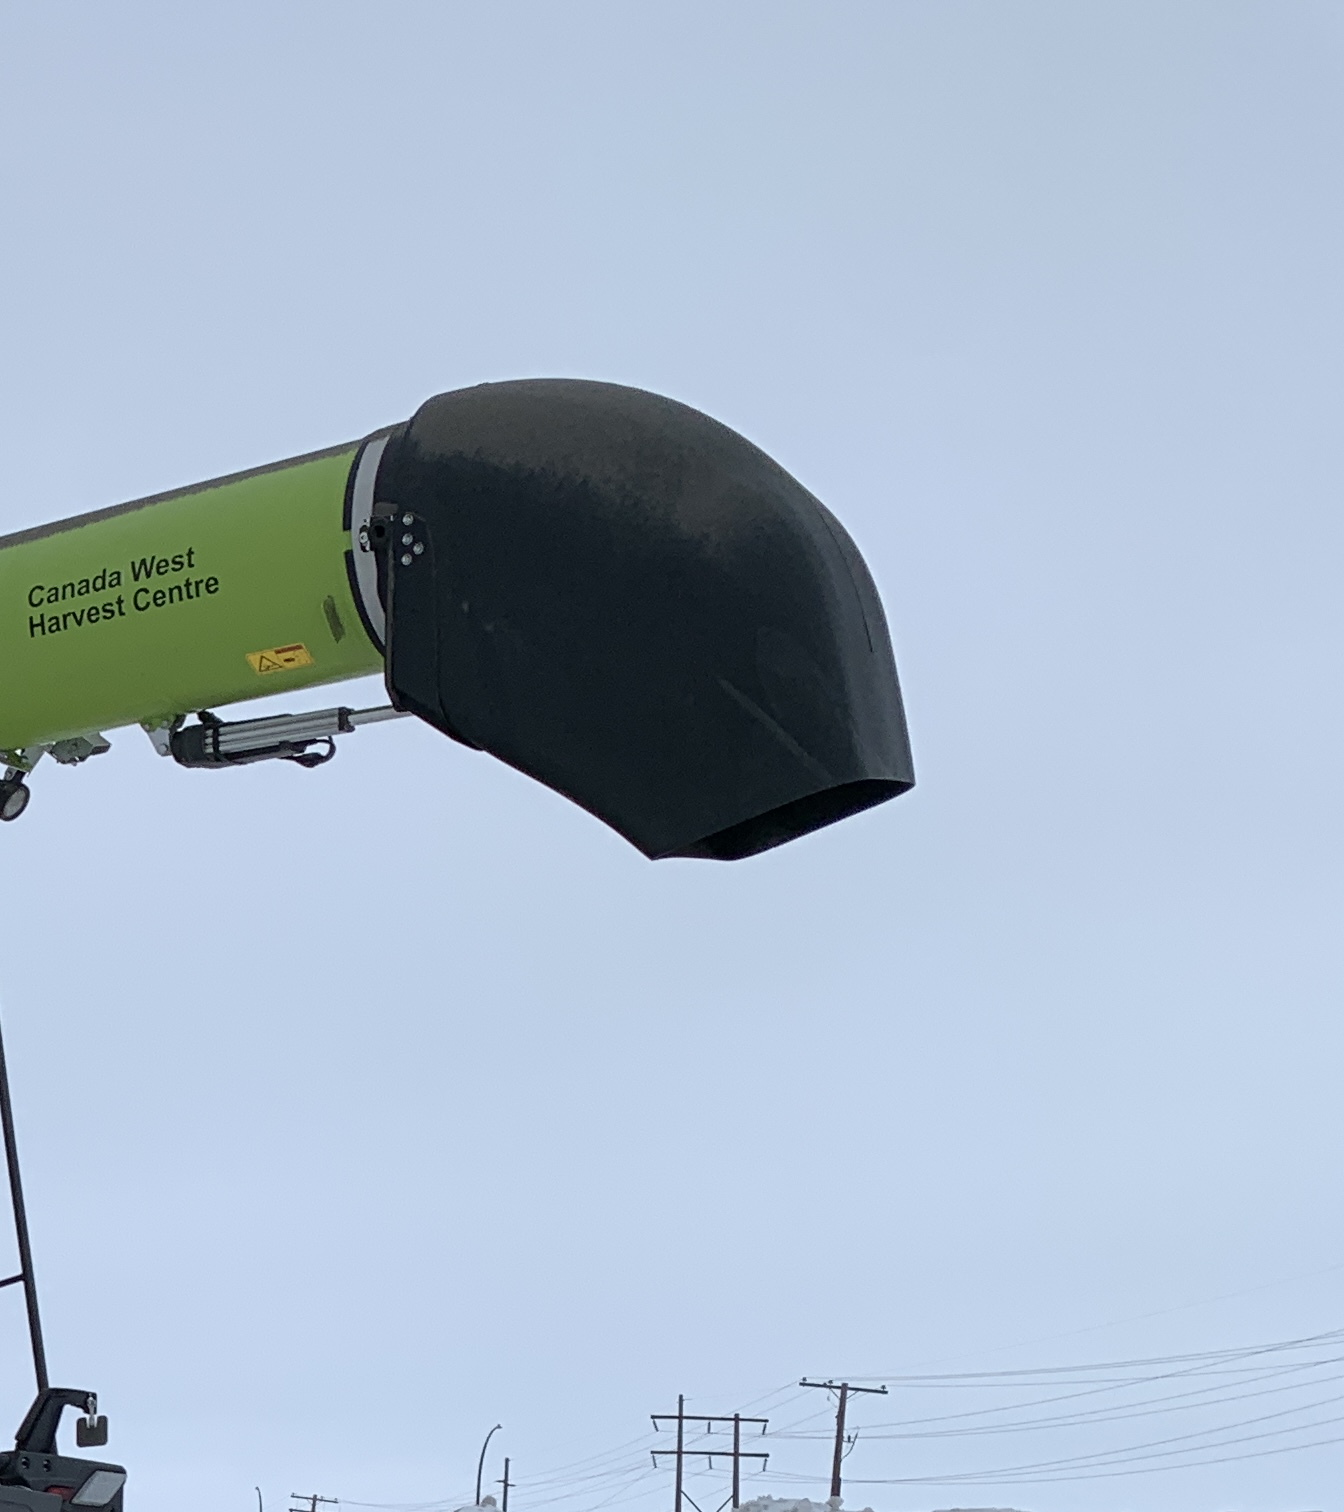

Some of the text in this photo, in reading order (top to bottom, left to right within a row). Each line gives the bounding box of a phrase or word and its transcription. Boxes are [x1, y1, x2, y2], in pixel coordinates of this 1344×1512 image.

[28, 547, 195, 608] Canada West
[28, 576, 219, 638] Harvest Centre
